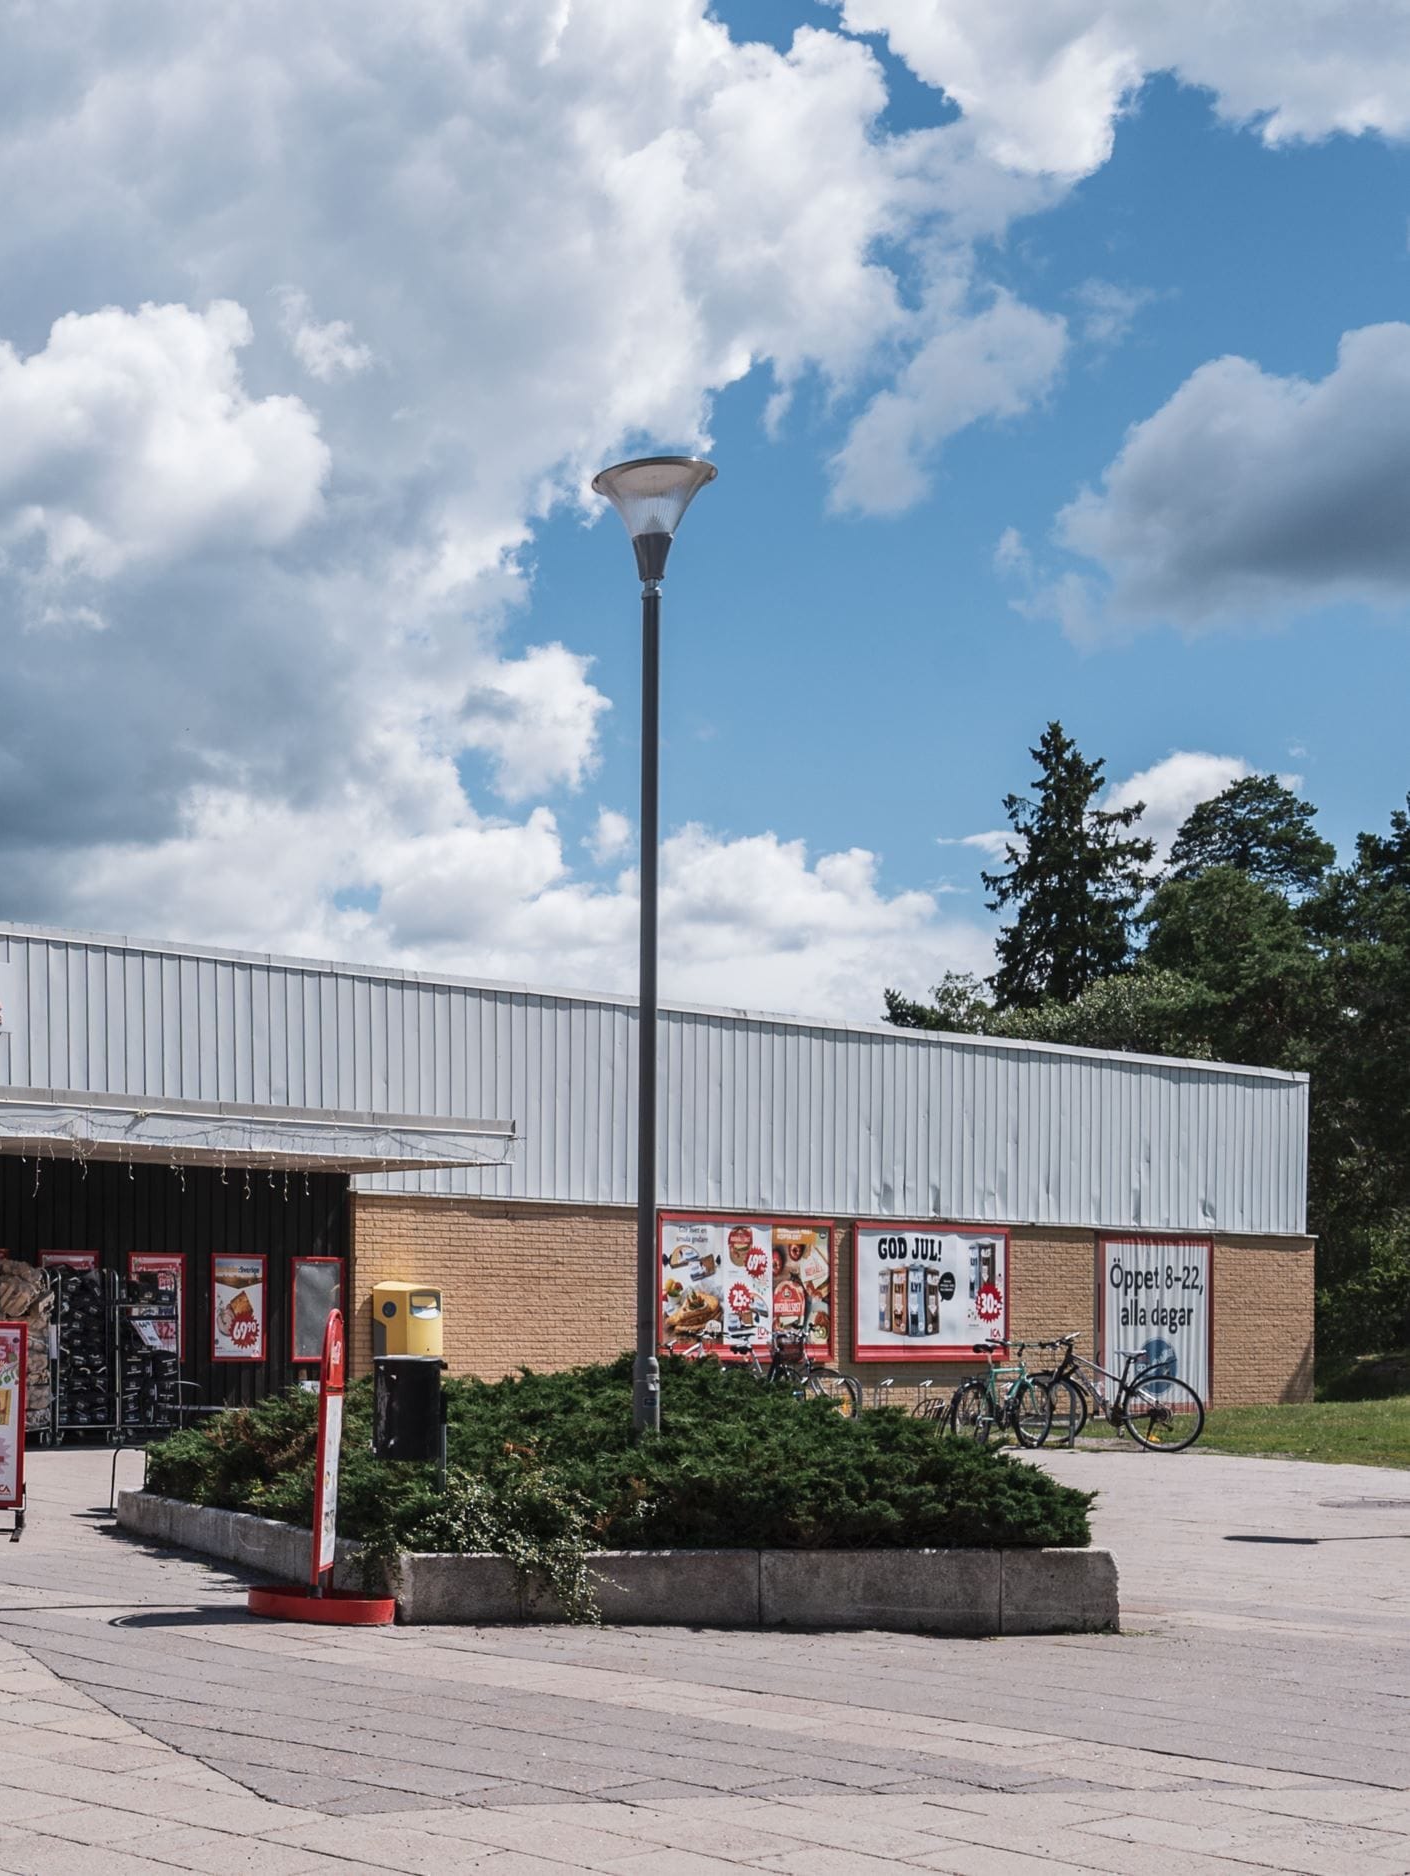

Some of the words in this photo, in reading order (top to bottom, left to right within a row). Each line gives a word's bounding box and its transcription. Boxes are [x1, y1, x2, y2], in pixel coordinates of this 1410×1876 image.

[877, 1236, 907, 1261] GOD
[912, 1237, 942, 1262] JUL!
[1109, 1257, 1159, 1297] Öppet
[1121, 1299, 1147, 1327] alla
[1151, 1300, 1194, 1335] dagar
